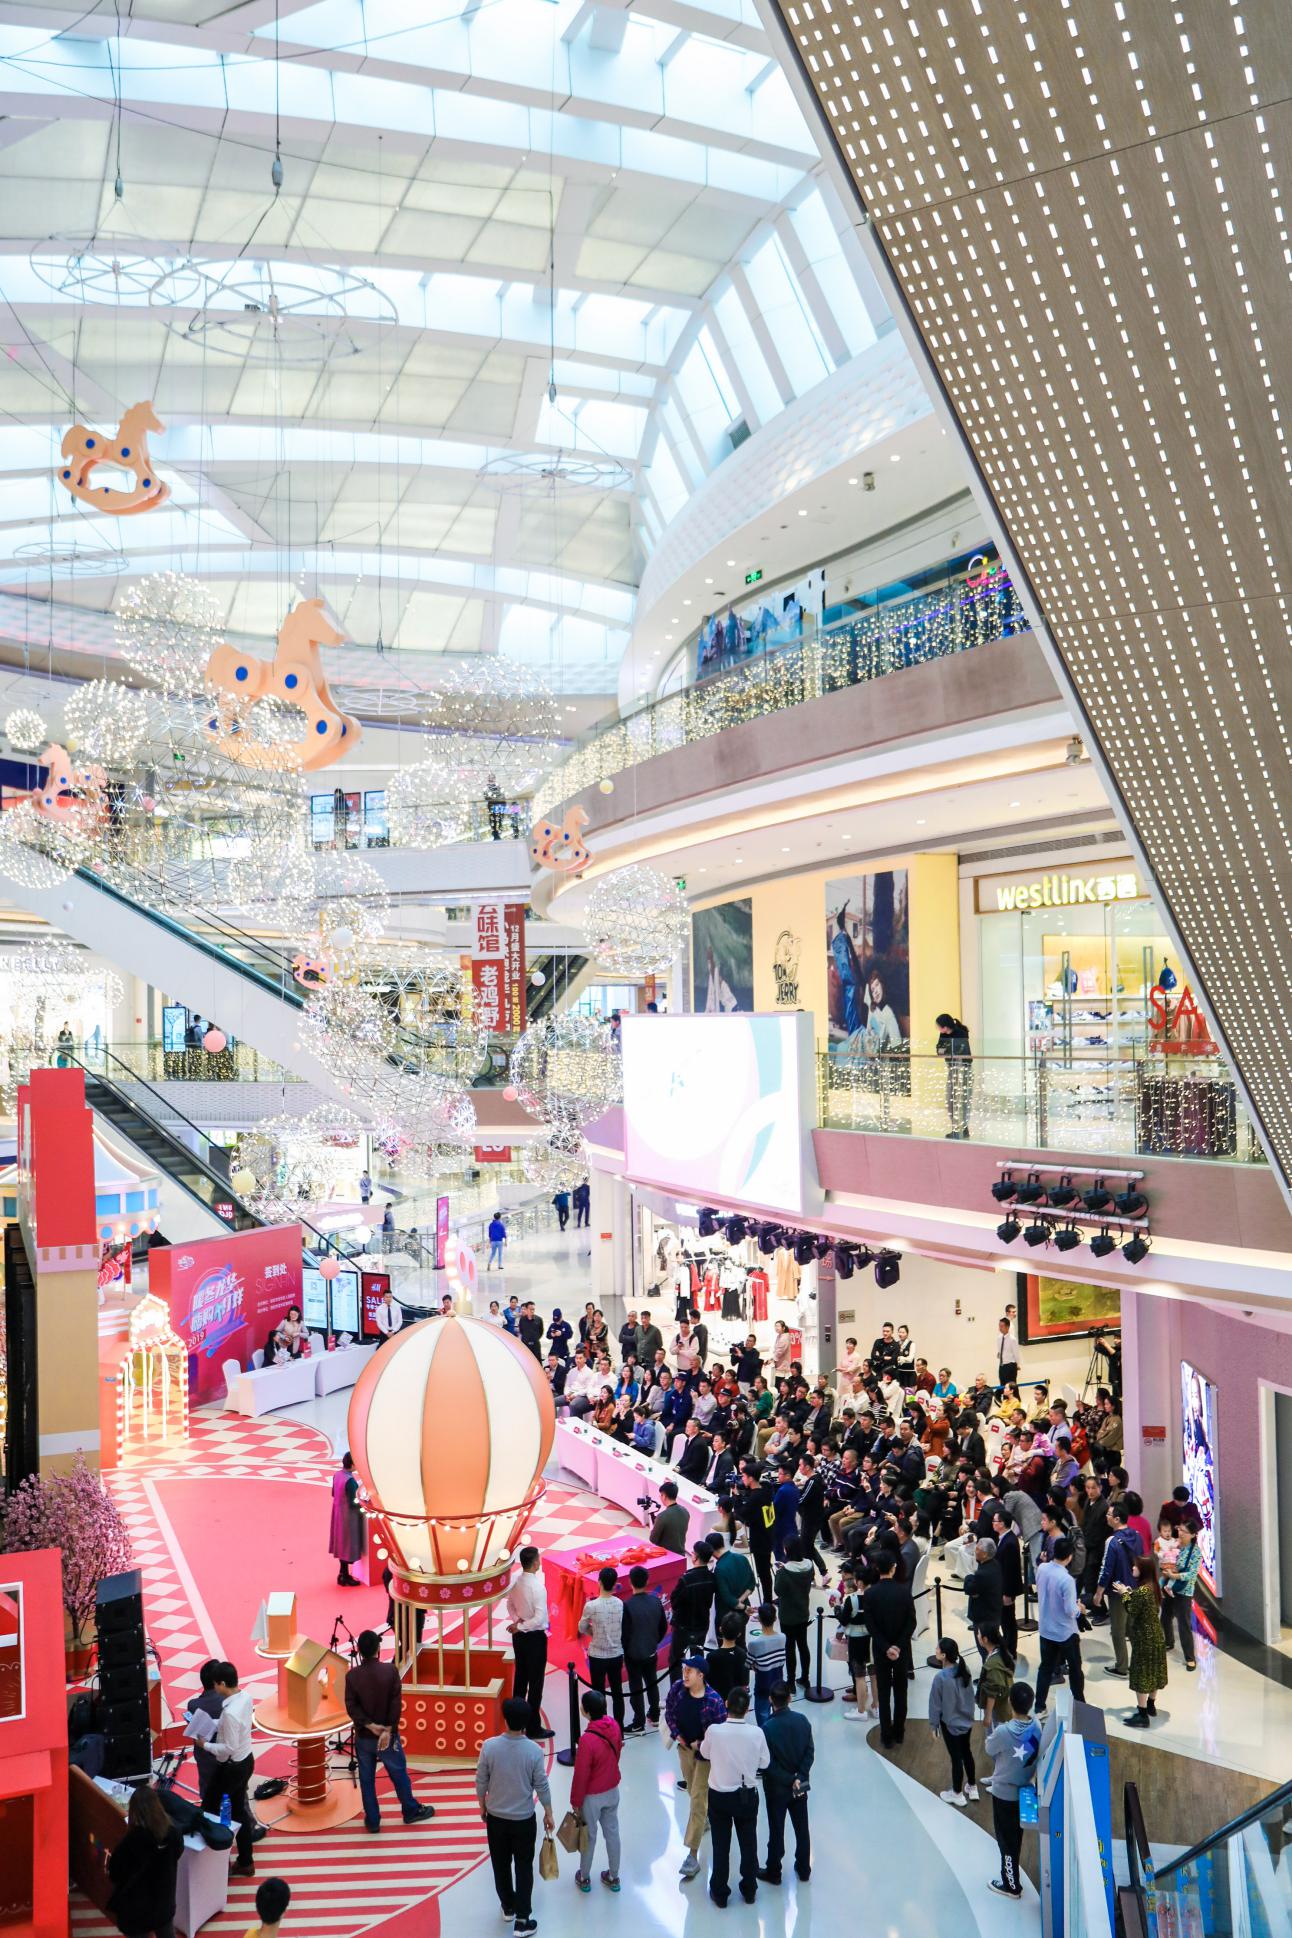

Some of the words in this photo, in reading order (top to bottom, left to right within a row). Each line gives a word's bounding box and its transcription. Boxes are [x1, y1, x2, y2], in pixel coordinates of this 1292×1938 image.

[997, 873, 1096, 911] westlink
[776, 982, 799, 1002] JERRY
[264, 1263, 287, 1279] 签到处
[188, 1332, 205, 1347] 2019
[1004, 1855, 1016, 1890] adidas
